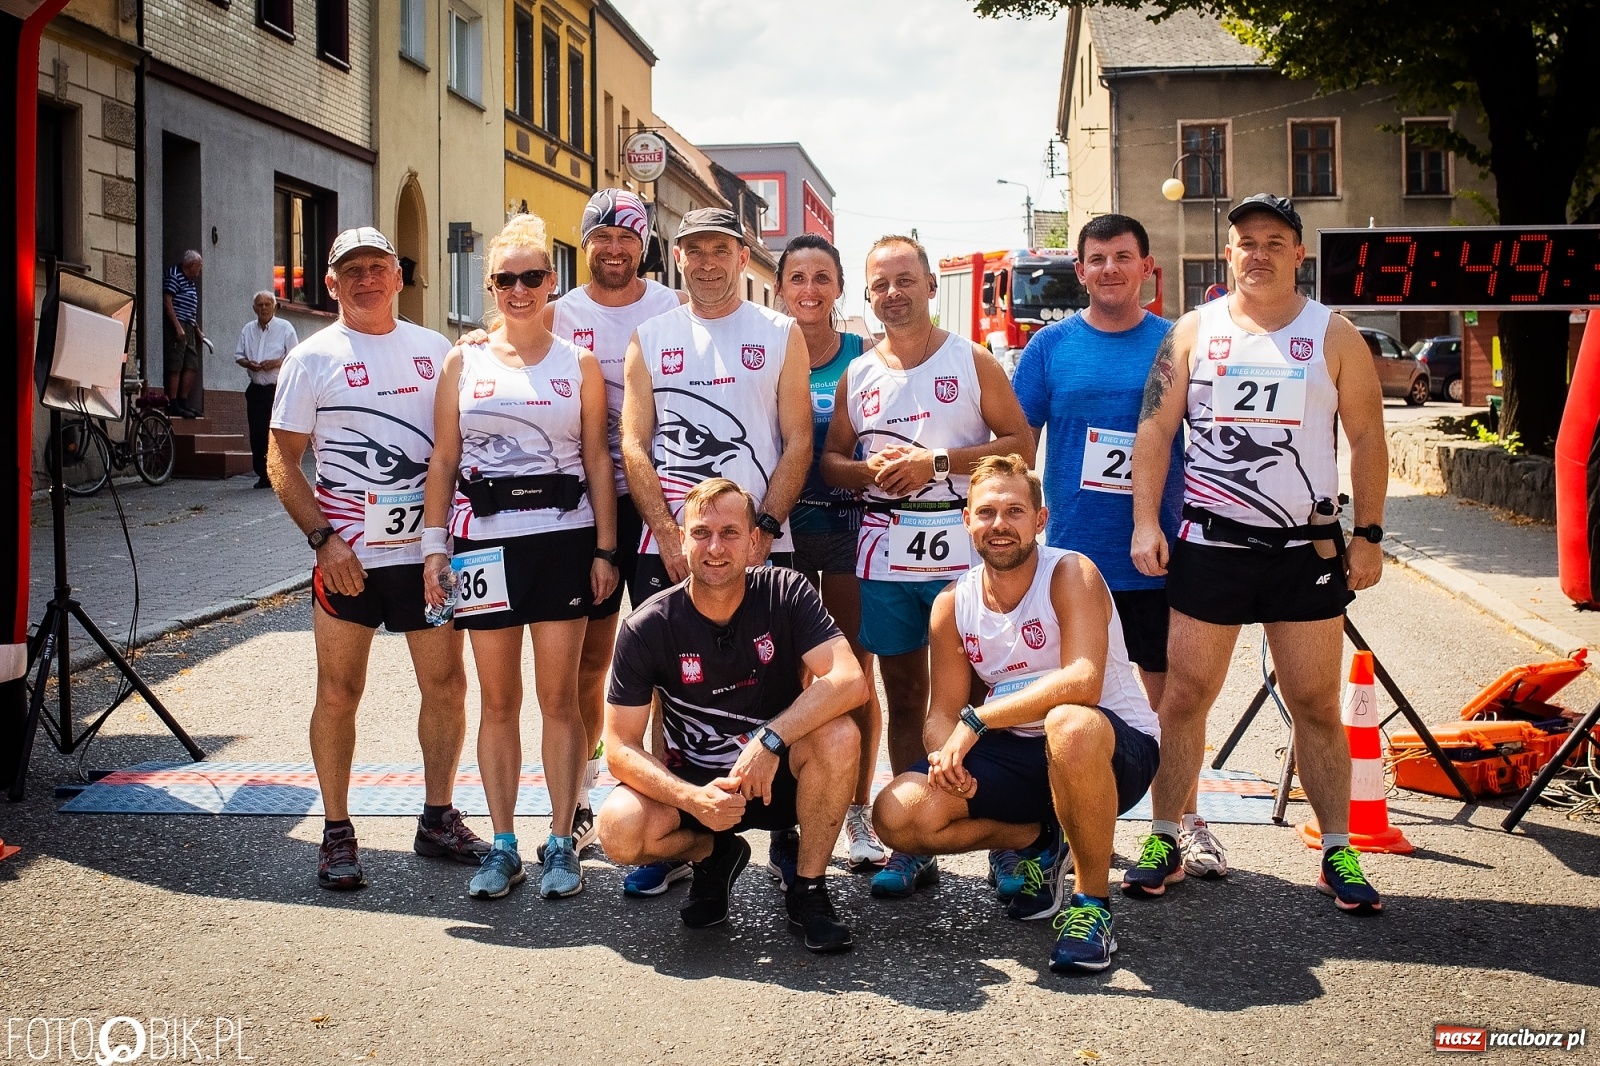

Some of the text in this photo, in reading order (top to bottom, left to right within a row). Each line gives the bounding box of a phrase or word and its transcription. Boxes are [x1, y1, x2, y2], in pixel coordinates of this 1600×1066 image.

[630, 152, 660, 162] TYSKIE
[1354, 234, 1600, 302] 13:49:
[1250, 368, 1302, 378] KRZANOWICKI
[1234, 381, 1279, 412] 21
[385, 504, 424, 535] 37
[906, 530, 949, 561] 46
[461, 568, 487, 600] 36
[1316, 573, 1331, 585] 4F
